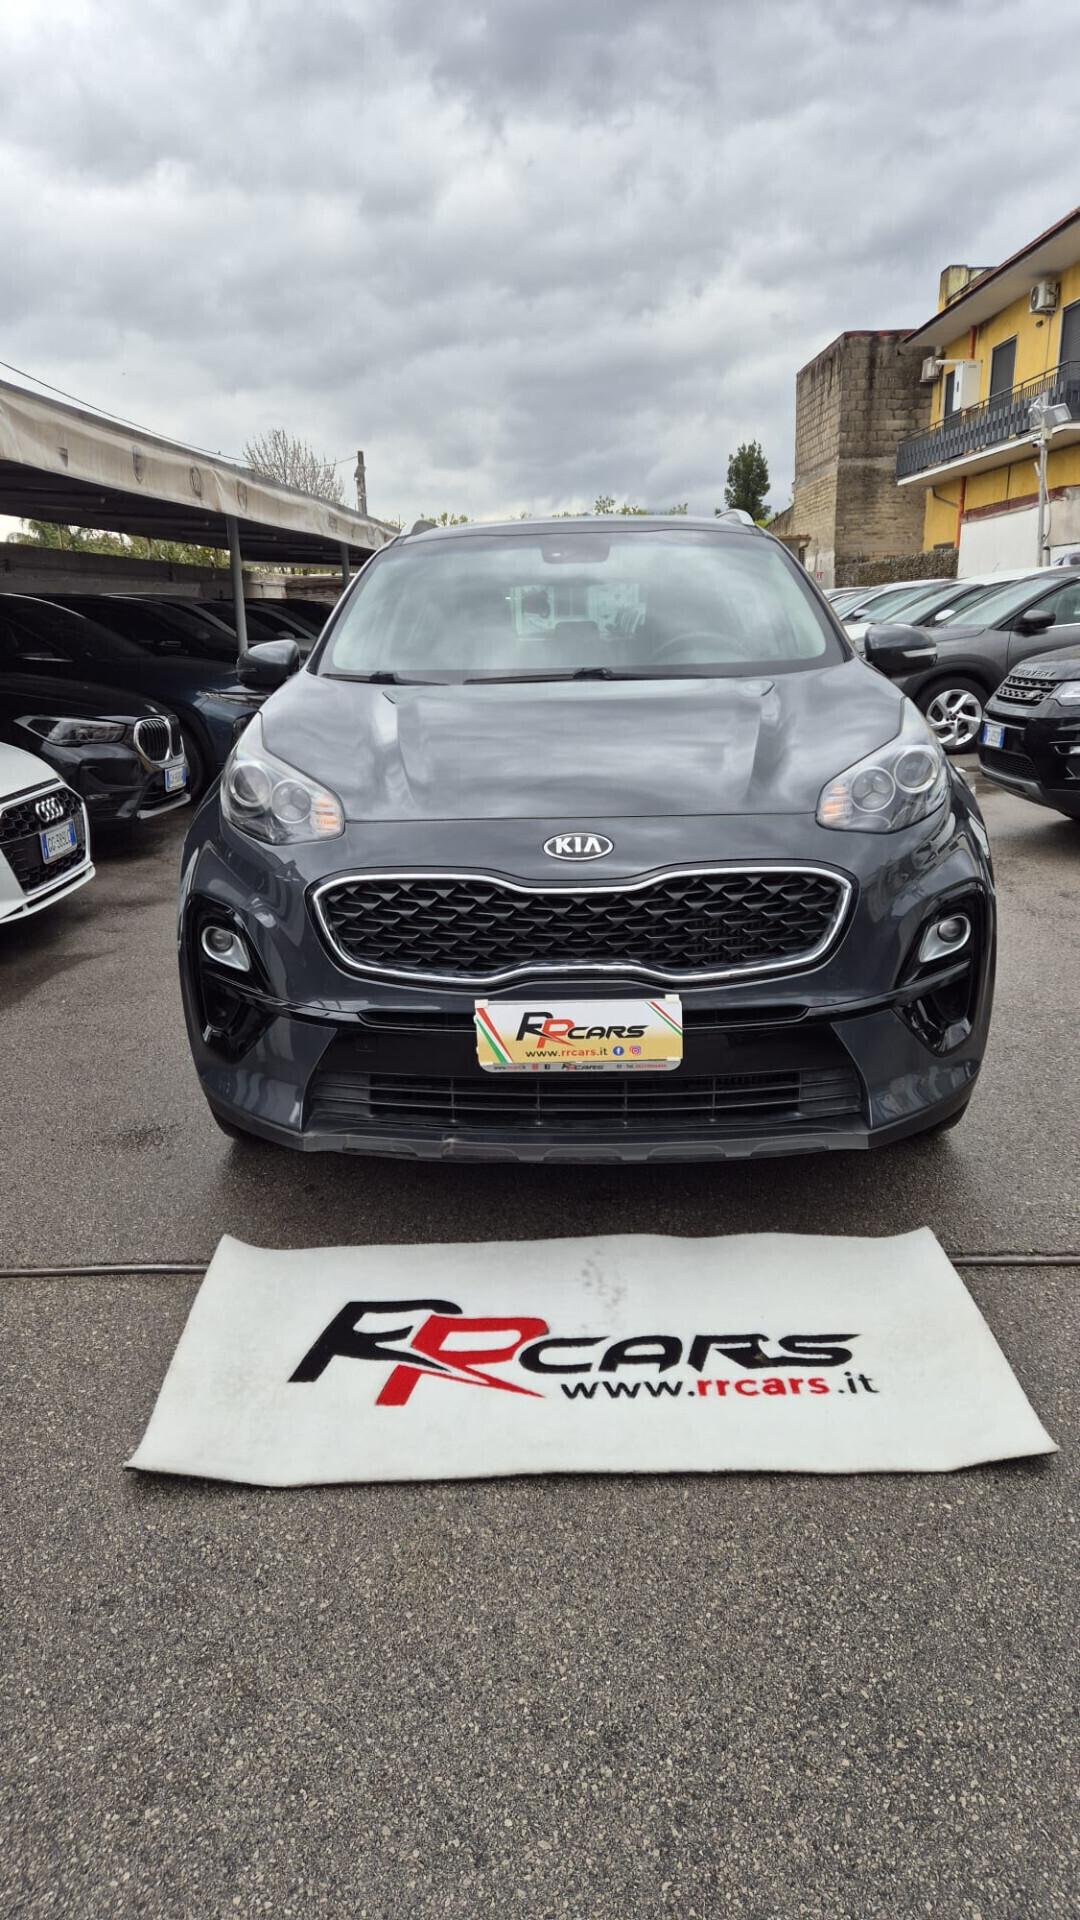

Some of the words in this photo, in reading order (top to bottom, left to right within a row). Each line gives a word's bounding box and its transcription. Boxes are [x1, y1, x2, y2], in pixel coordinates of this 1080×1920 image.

[555, 836, 602, 854] KIA
[525, 1047, 609, 1058] www.rrcars.it
[561, 1371, 880, 1399] www.rrcars.it
